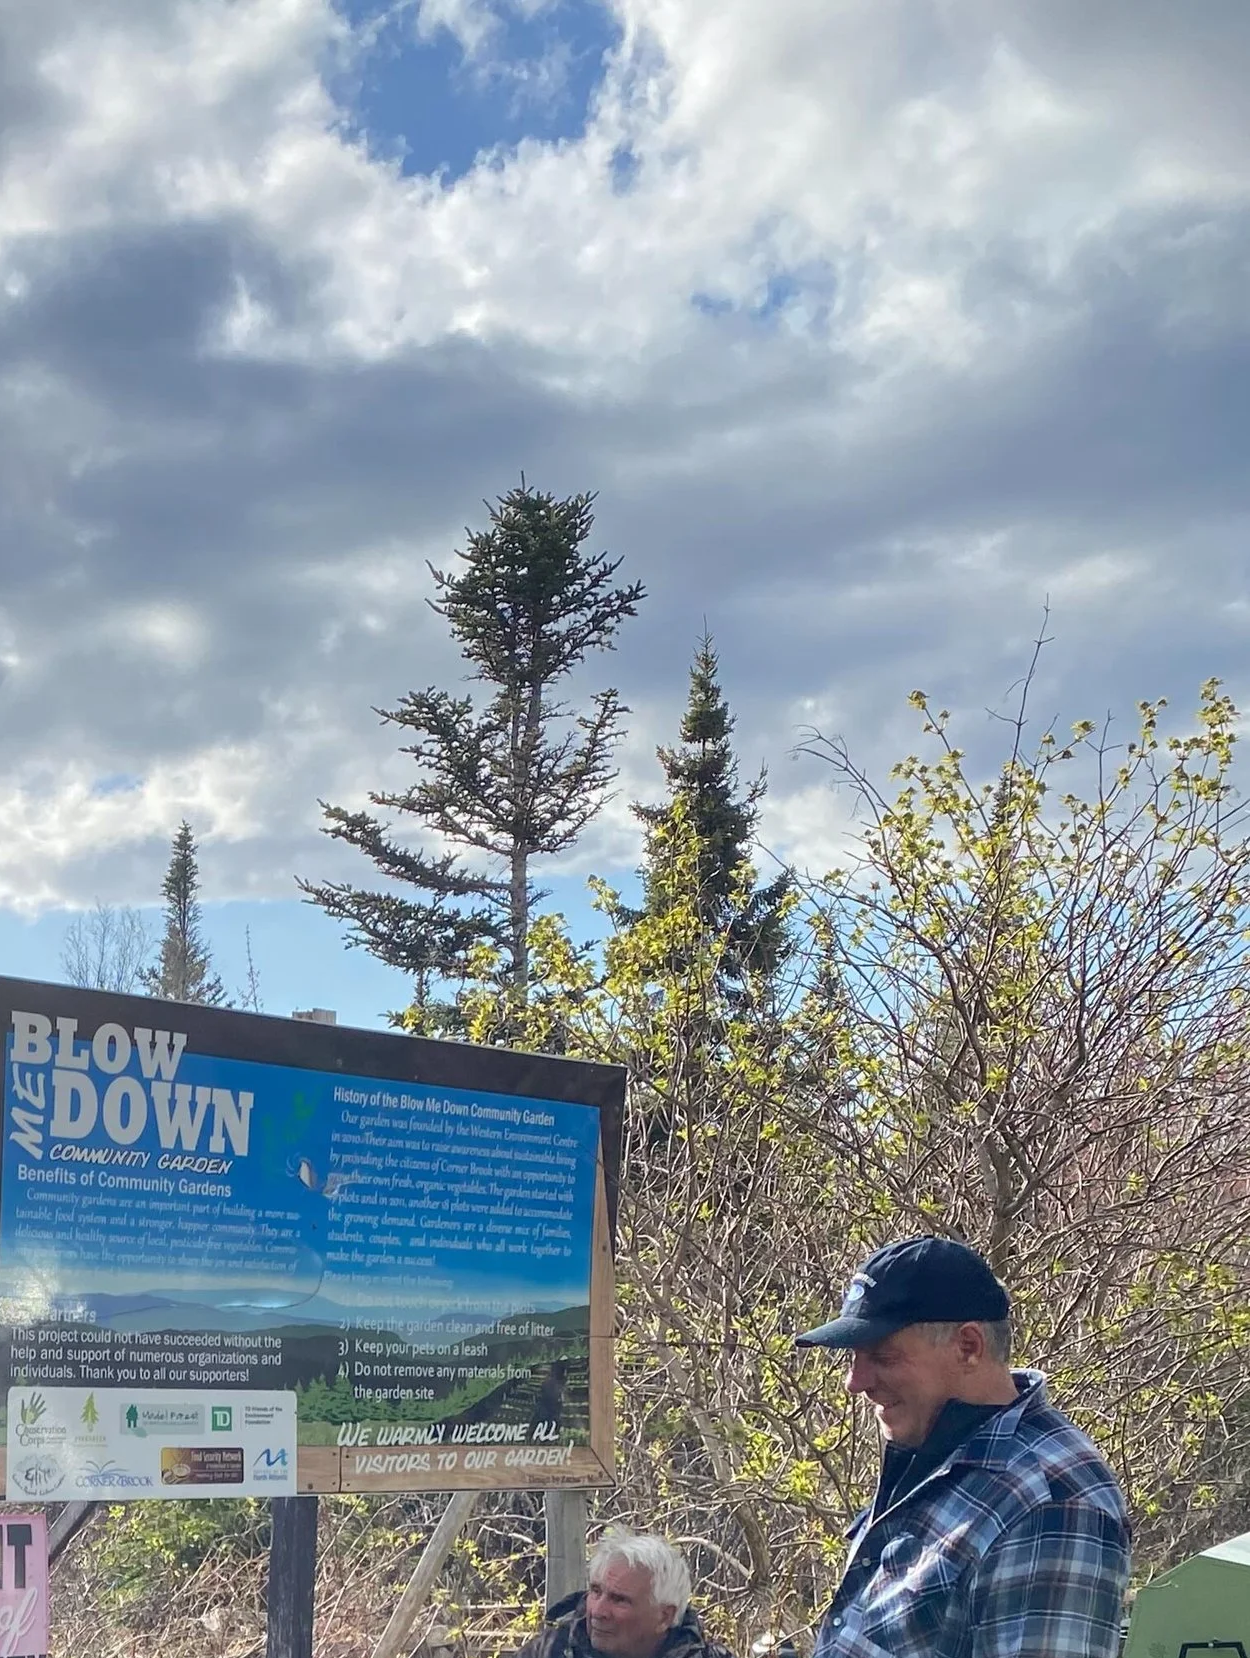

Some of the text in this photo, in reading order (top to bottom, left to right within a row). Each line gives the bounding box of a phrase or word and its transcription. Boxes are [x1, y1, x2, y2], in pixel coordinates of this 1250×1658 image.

[10, 1010, 187, 1081] BLOW
[9, 1063, 45, 1160] ME
[49, 1068, 254, 1157] DOWN
[334, 1086, 554, 1126] History of the Blow Me Down Community Garden
[49, 1144, 233, 1174] COMMUNITY GARDEN
[17, 1164, 232, 1197] Benefits of Community Gardens
[11, 1327, 282, 1349] This project could not have succeeded without the
[339, 1316, 555, 1337] 2) Keep the garden clean and free of litter
[10, 1345, 282, 1367] help and support of numerous organizations and
[338, 1338, 488, 1358] 3) Keep your pets on a leash
[10, 1364, 250, 1384] individuals. Thank you to all our supporters!
[337, 1361, 532, 1381] 4) Do not remove any materials from
[354, 1383, 435, 1403] the garden site
[214, 1411, 230, 1426] TD
[337, 1420, 559, 1447] WE WARMLY WELCOME ALL
[356, 1440, 574, 1474] VISITORS TO OUR GARDEN!
